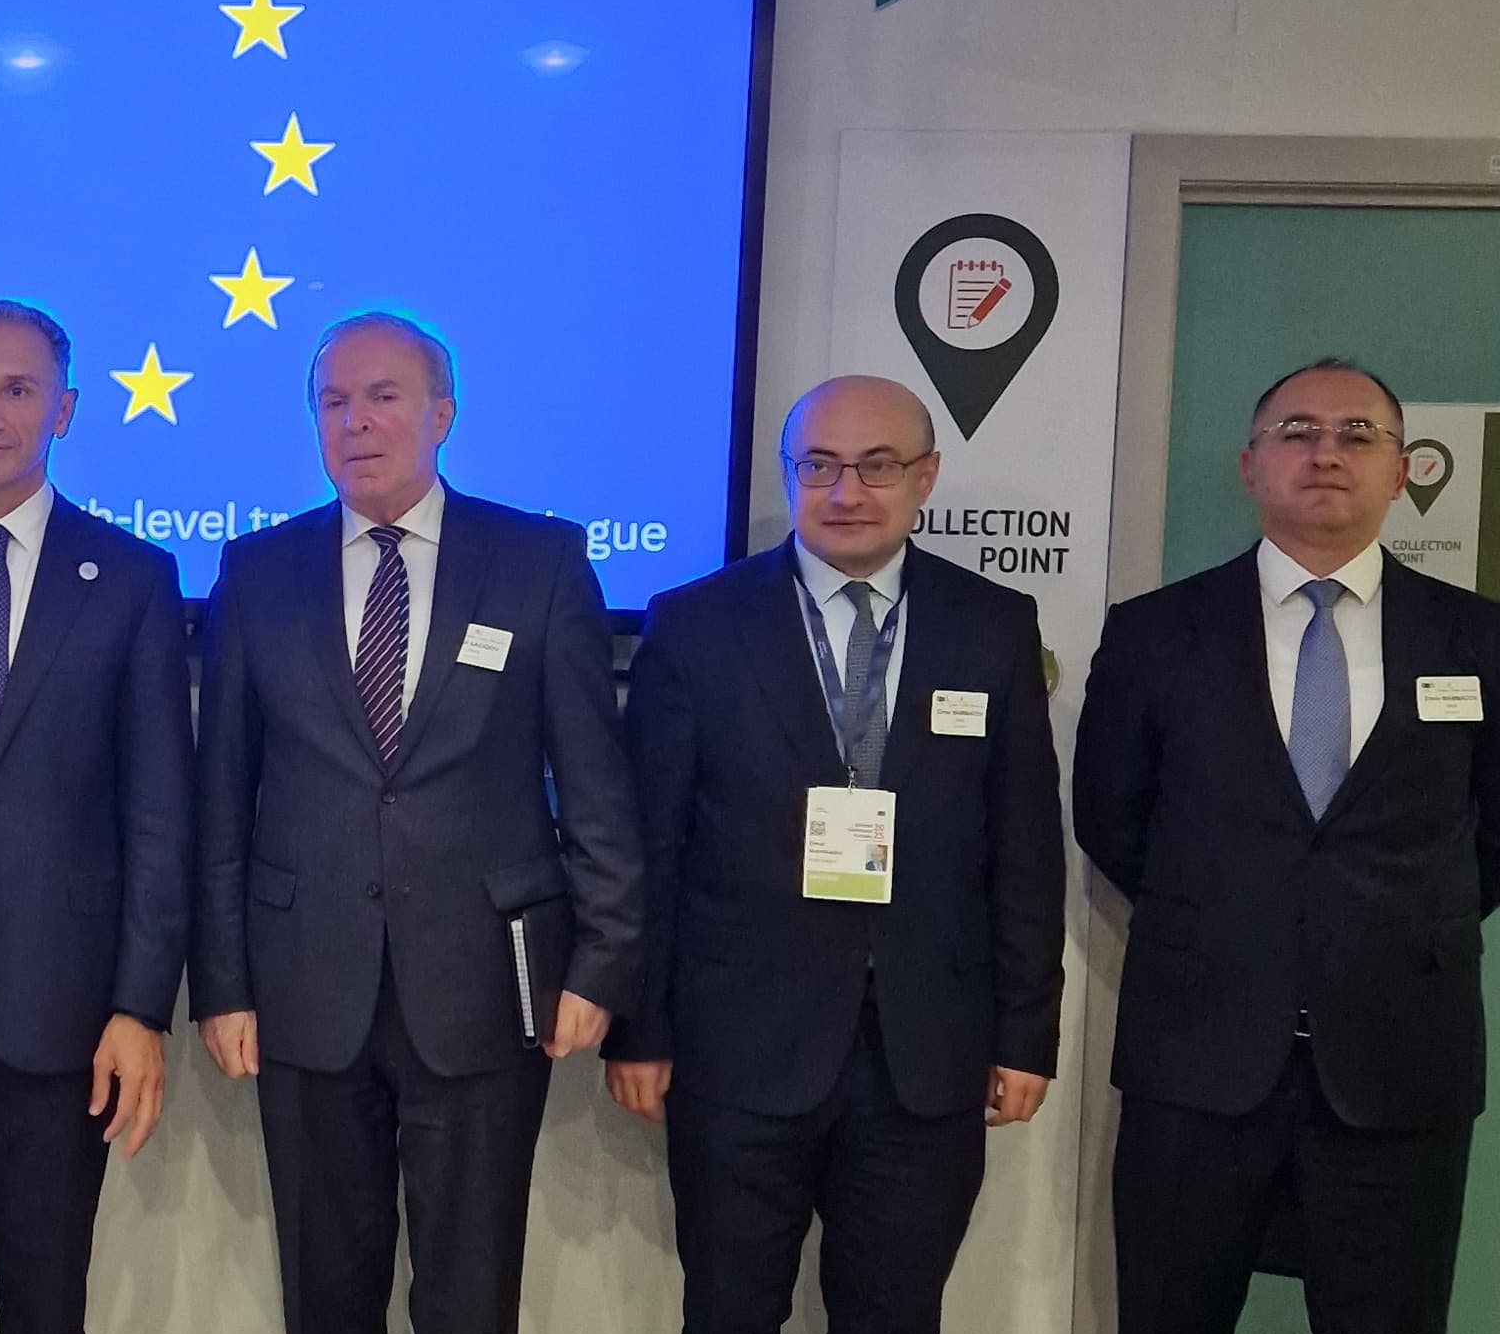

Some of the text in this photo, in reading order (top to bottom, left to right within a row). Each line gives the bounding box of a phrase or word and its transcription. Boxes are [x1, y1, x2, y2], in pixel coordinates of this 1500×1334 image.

[911, 508, 1071, 537] OLLECTION
[1392, 540, 1462, 551] COLLECTION
[979, 546, 1070, 574] POINT
